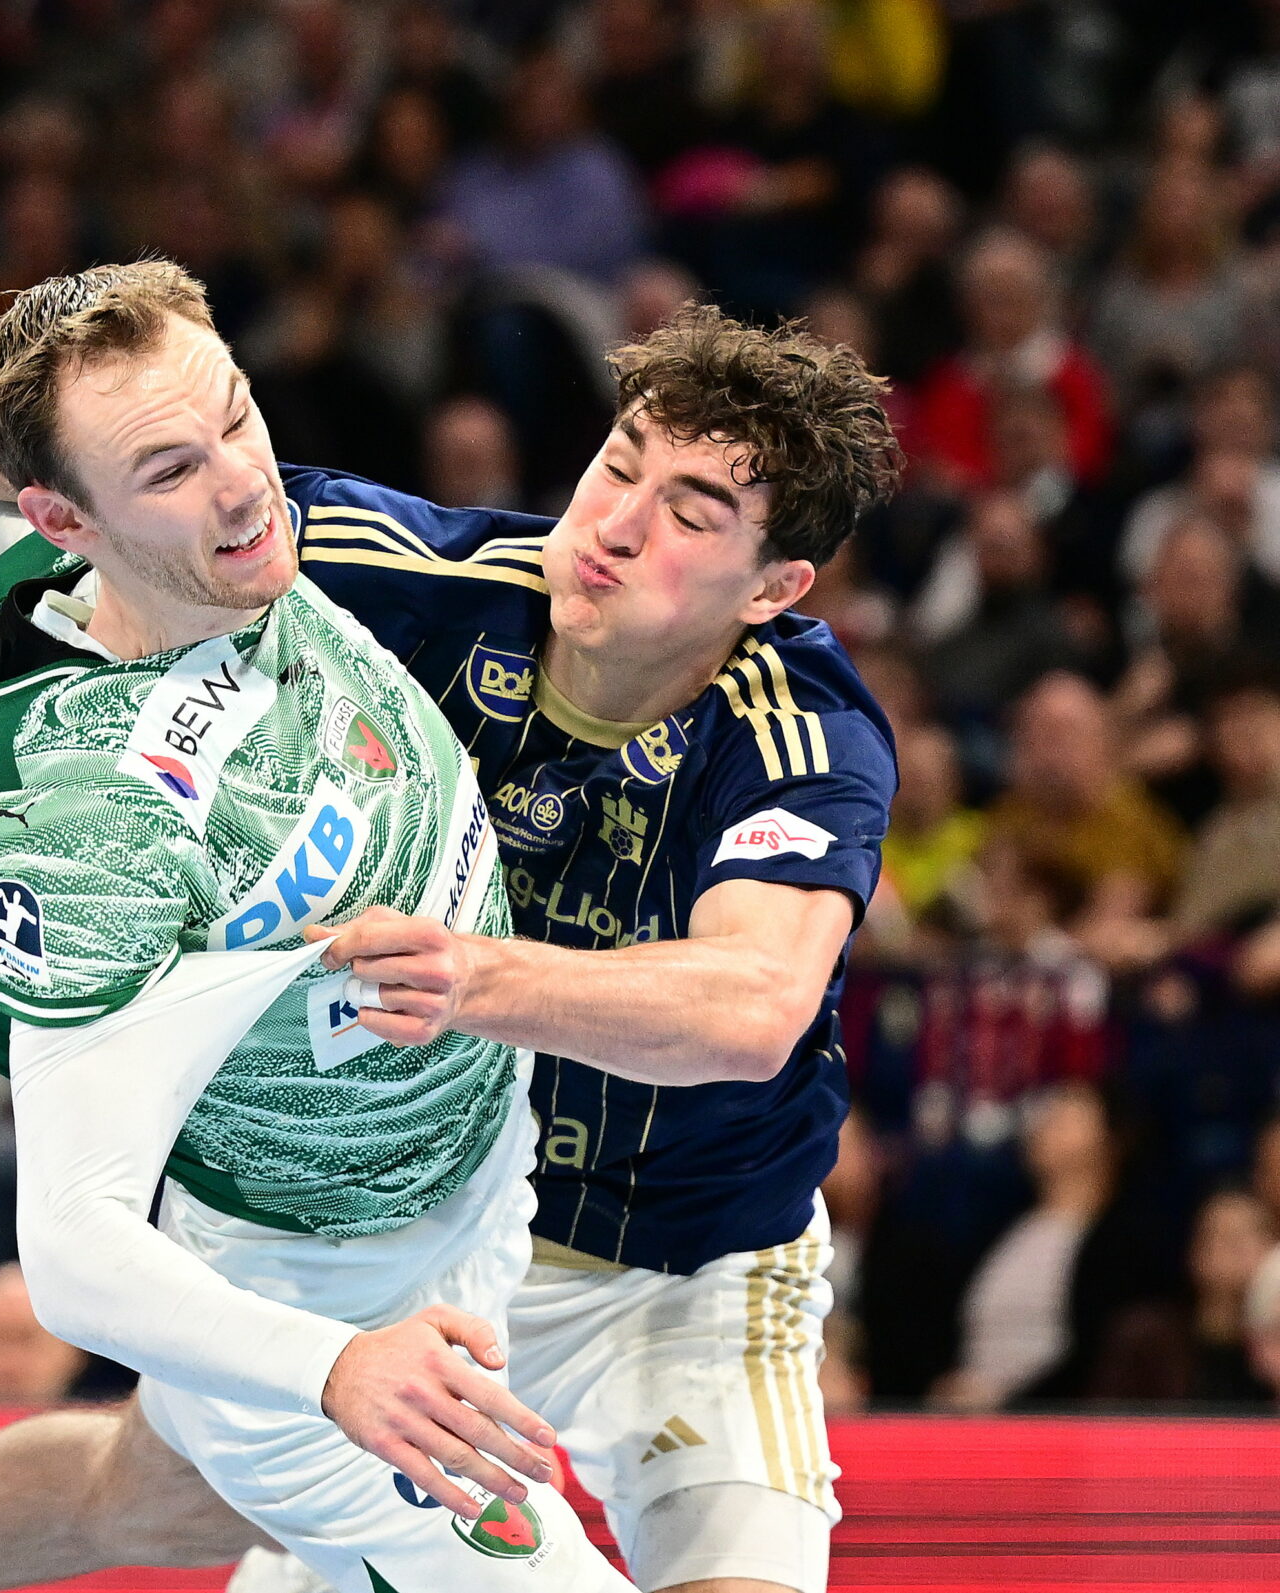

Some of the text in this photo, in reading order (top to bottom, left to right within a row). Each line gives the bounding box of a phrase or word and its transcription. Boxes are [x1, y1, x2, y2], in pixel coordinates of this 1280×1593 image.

[164, 661, 241, 757] BEW
[494, 782, 538, 817] AOK
[734, 830, 782, 851] LBS
[225, 804, 355, 951] DKB
[502, 864, 660, 948] g-Lloyd
[6, 951, 40, 976] DAIKIN
